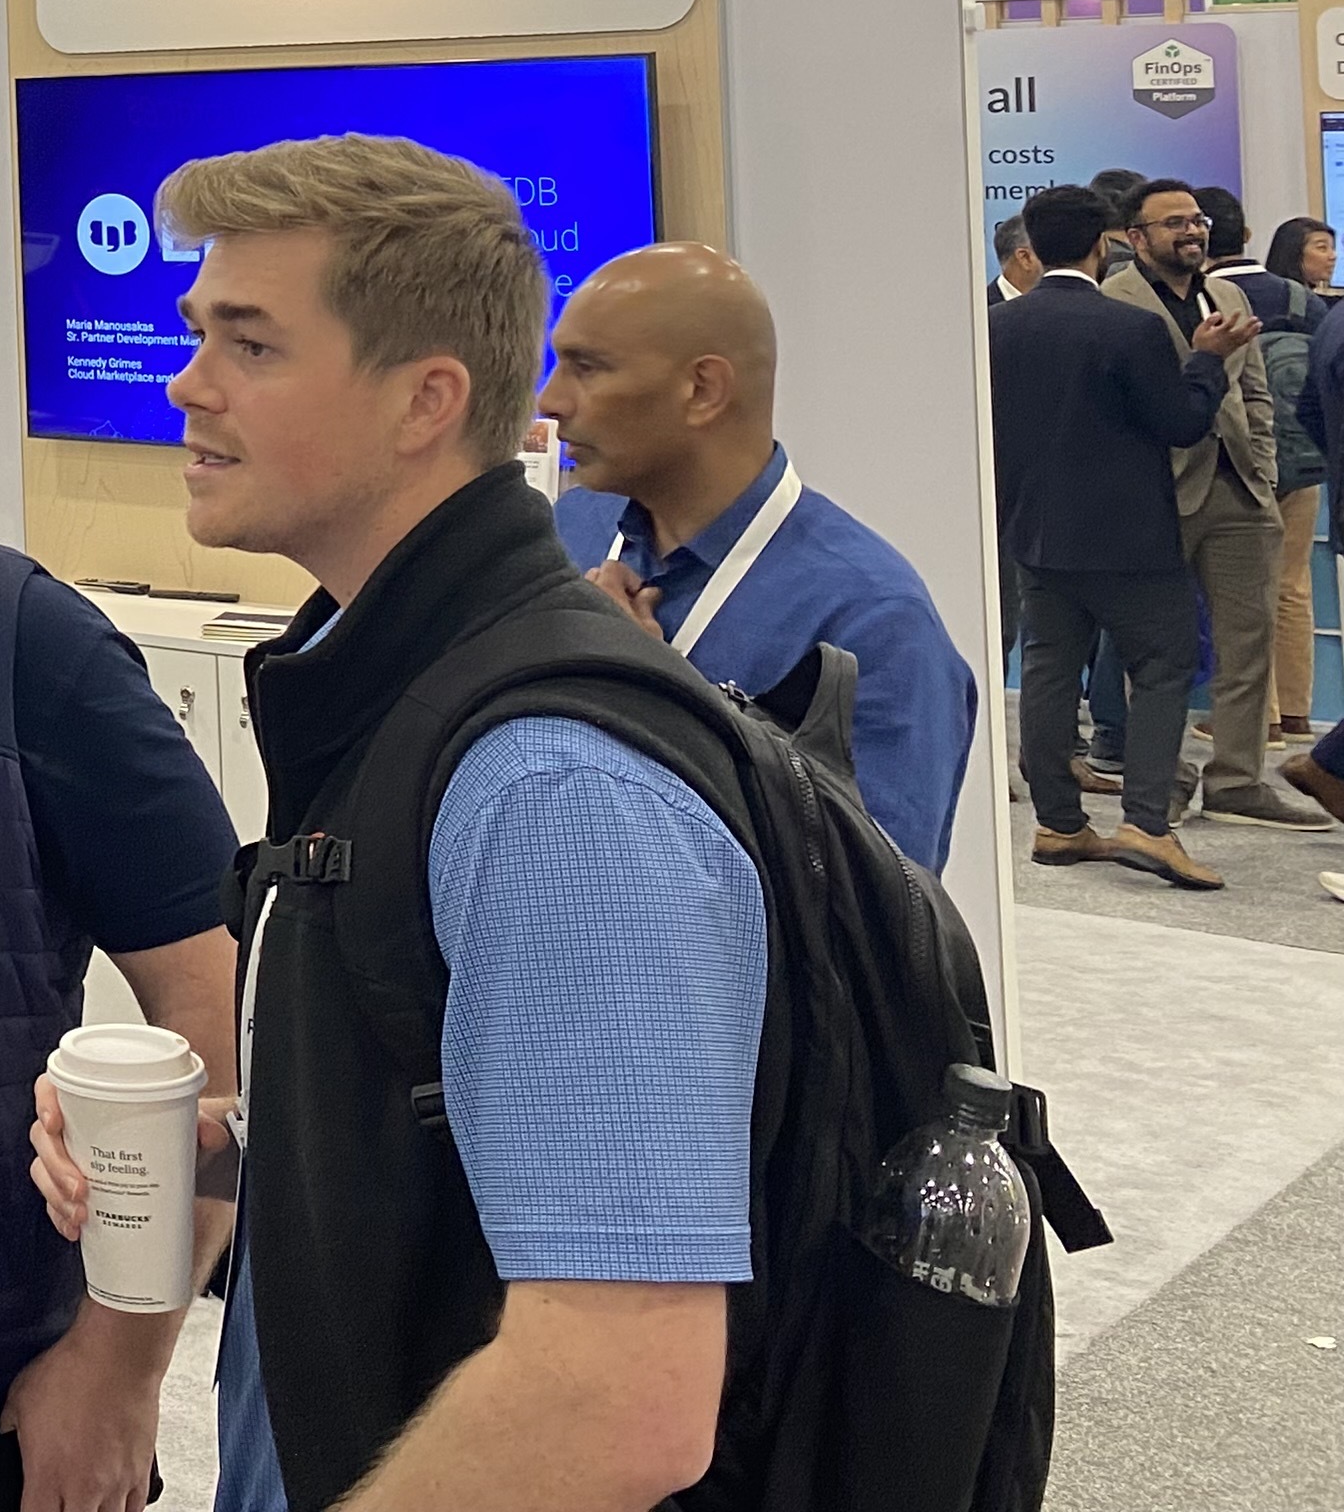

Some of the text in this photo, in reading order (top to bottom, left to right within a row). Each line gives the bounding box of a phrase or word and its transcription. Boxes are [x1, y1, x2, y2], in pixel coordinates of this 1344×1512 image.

[1145, 62, 1202, 76] FinOps
[987, 76, 1036, 113] all
[1152, 92, 1198, 102] Platform
[988, 145, 1055, 164] costs
[503, 176, 559, 207] DB
[66, 319, 154, 332] Maria Manousakas
[66, 331, 80, 342] Sr.
[81, 331, 115, 343] Partner
[116, 332, 178, 347] Development
[67, 356, 142, 369] Kennedy Grimes
[67, 368, 174, 384] Cloud Marketplace and
[90, 1145, 143, 1161] That first
[90, 1161, 106, 1173] sip
[95, 1209, 150, 1222] STARBUCKS
